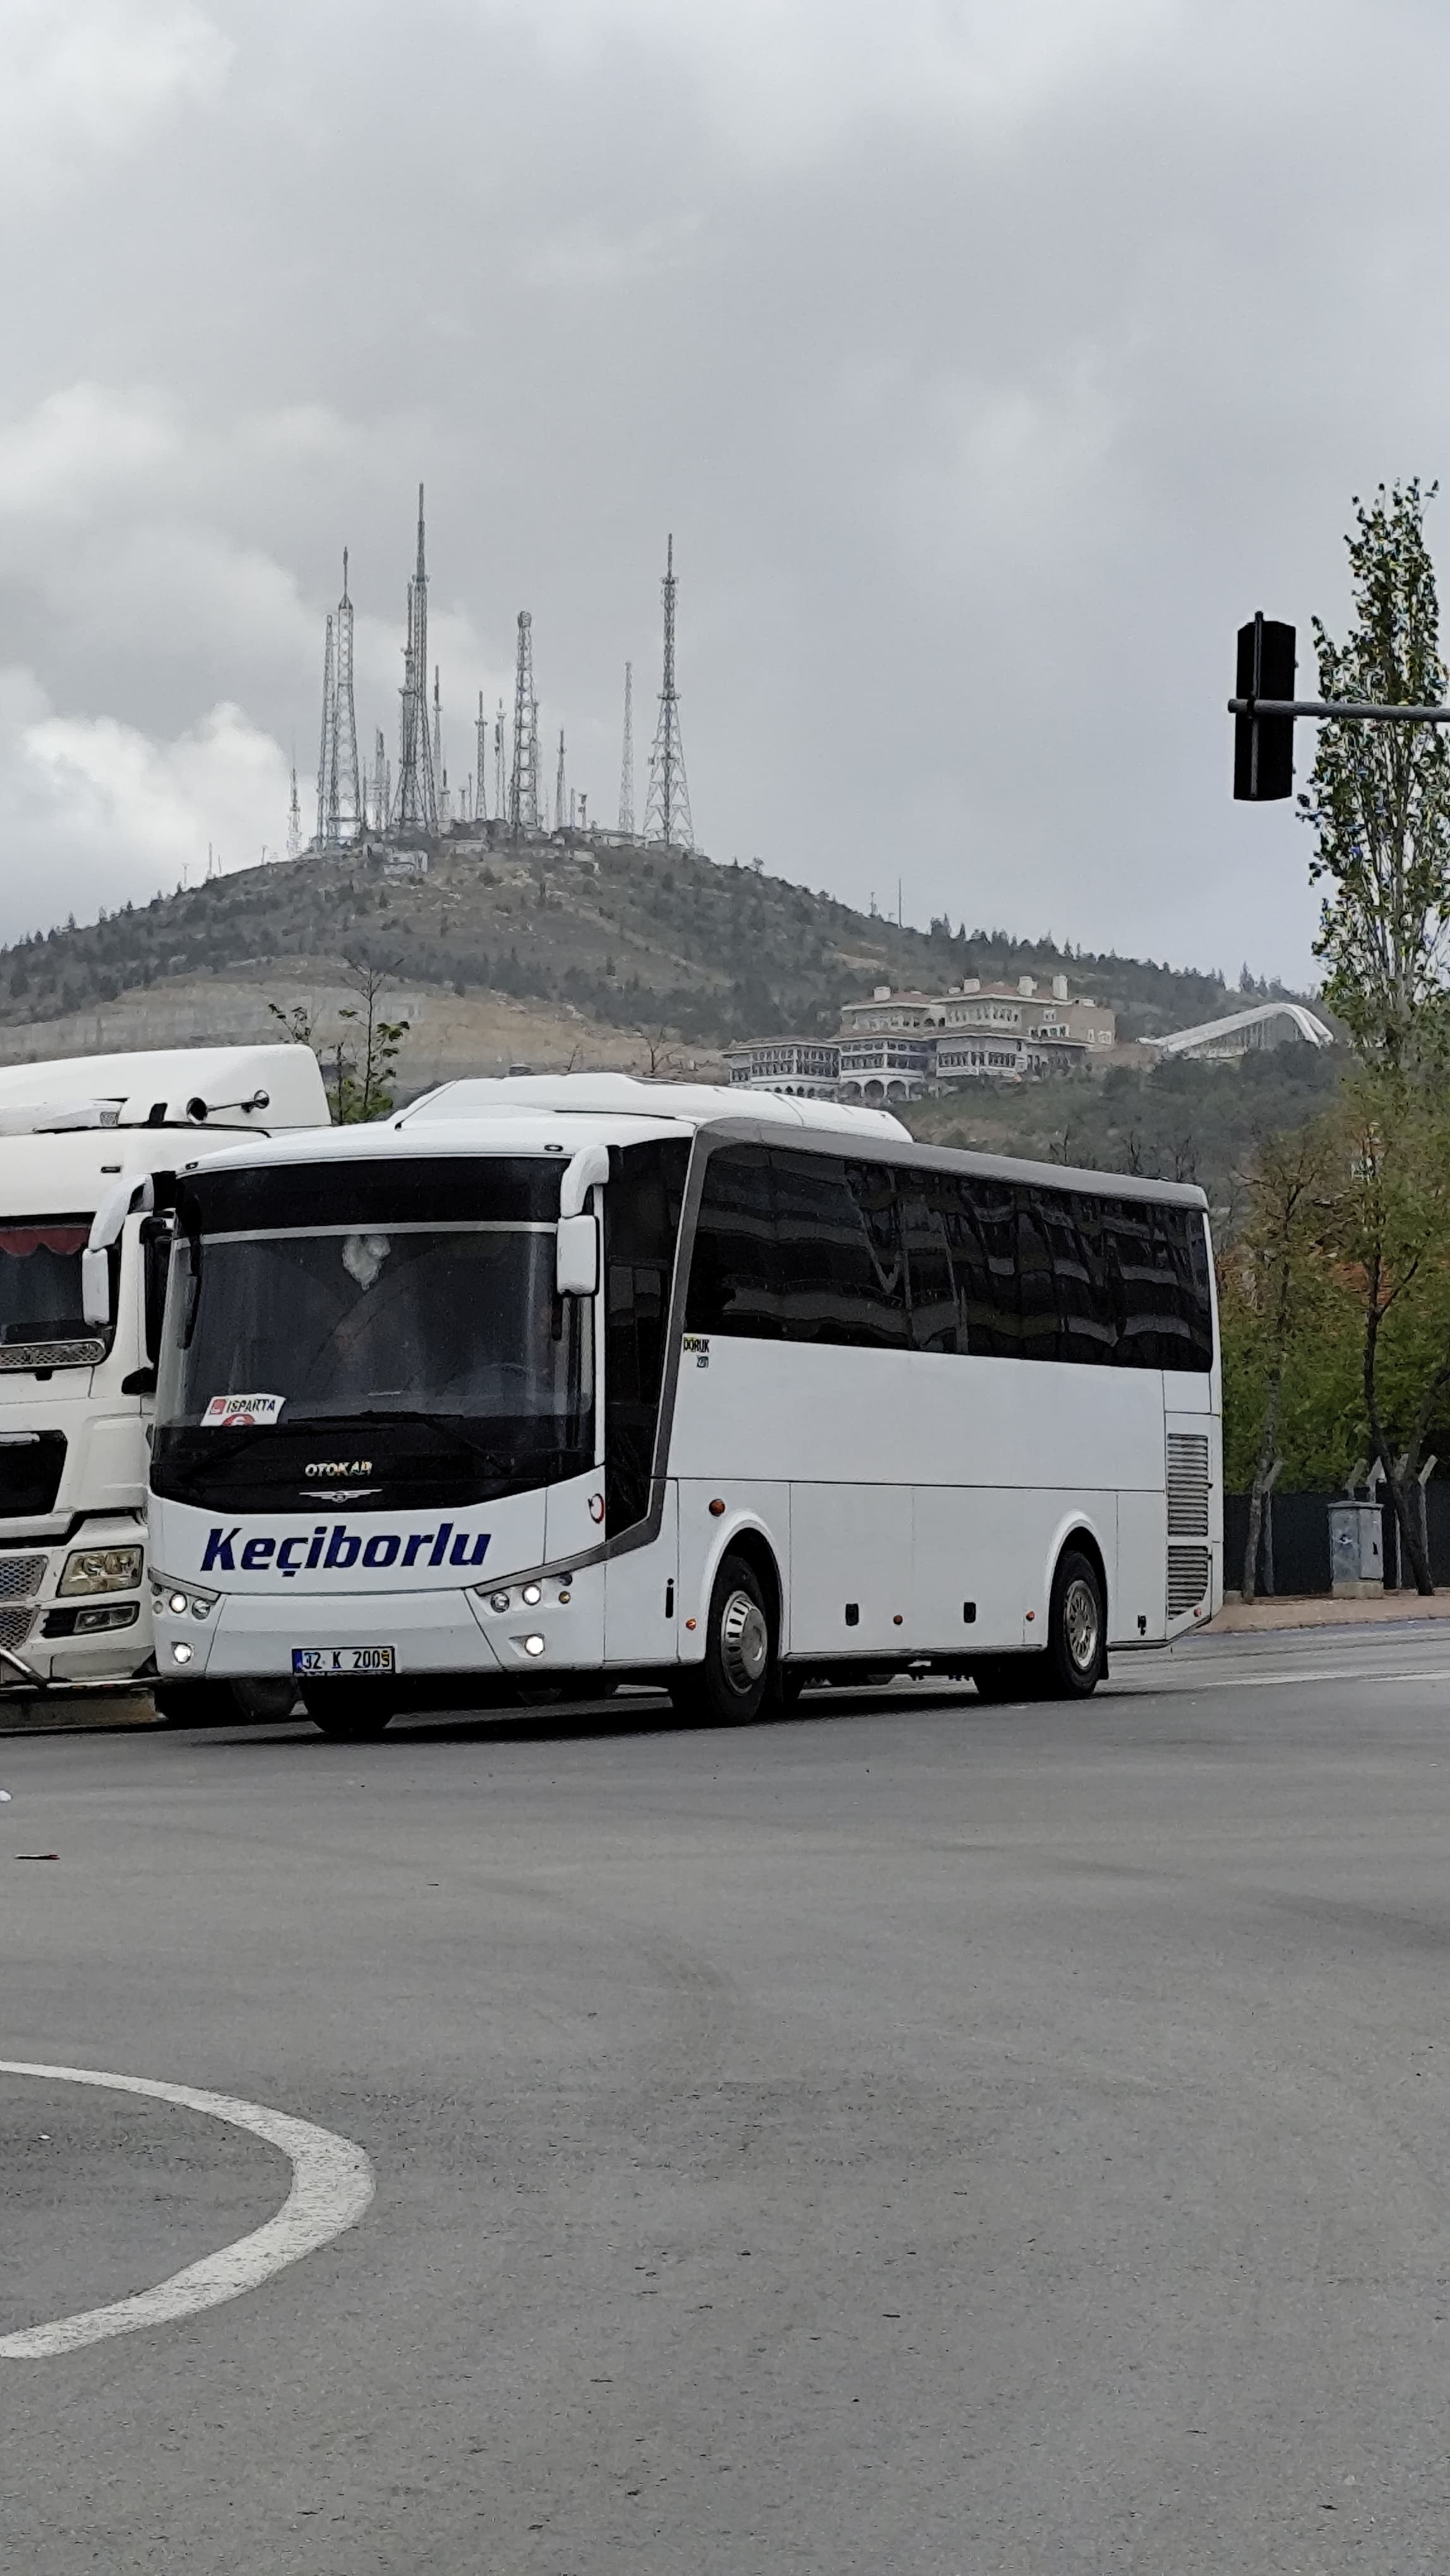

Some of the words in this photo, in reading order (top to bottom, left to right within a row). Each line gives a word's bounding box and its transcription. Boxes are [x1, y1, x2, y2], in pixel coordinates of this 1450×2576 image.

[226, 1398, 276, 1414] ISPARTA
[305, 1460, 373, 1476] OTOKAR
[200, 1520, 491, 1577] Keçiborlu
[303, 1652, 323, 1669] 32
[332, 1651, 342, 1669] K
[352, 1650, 390, 1669] 2009
